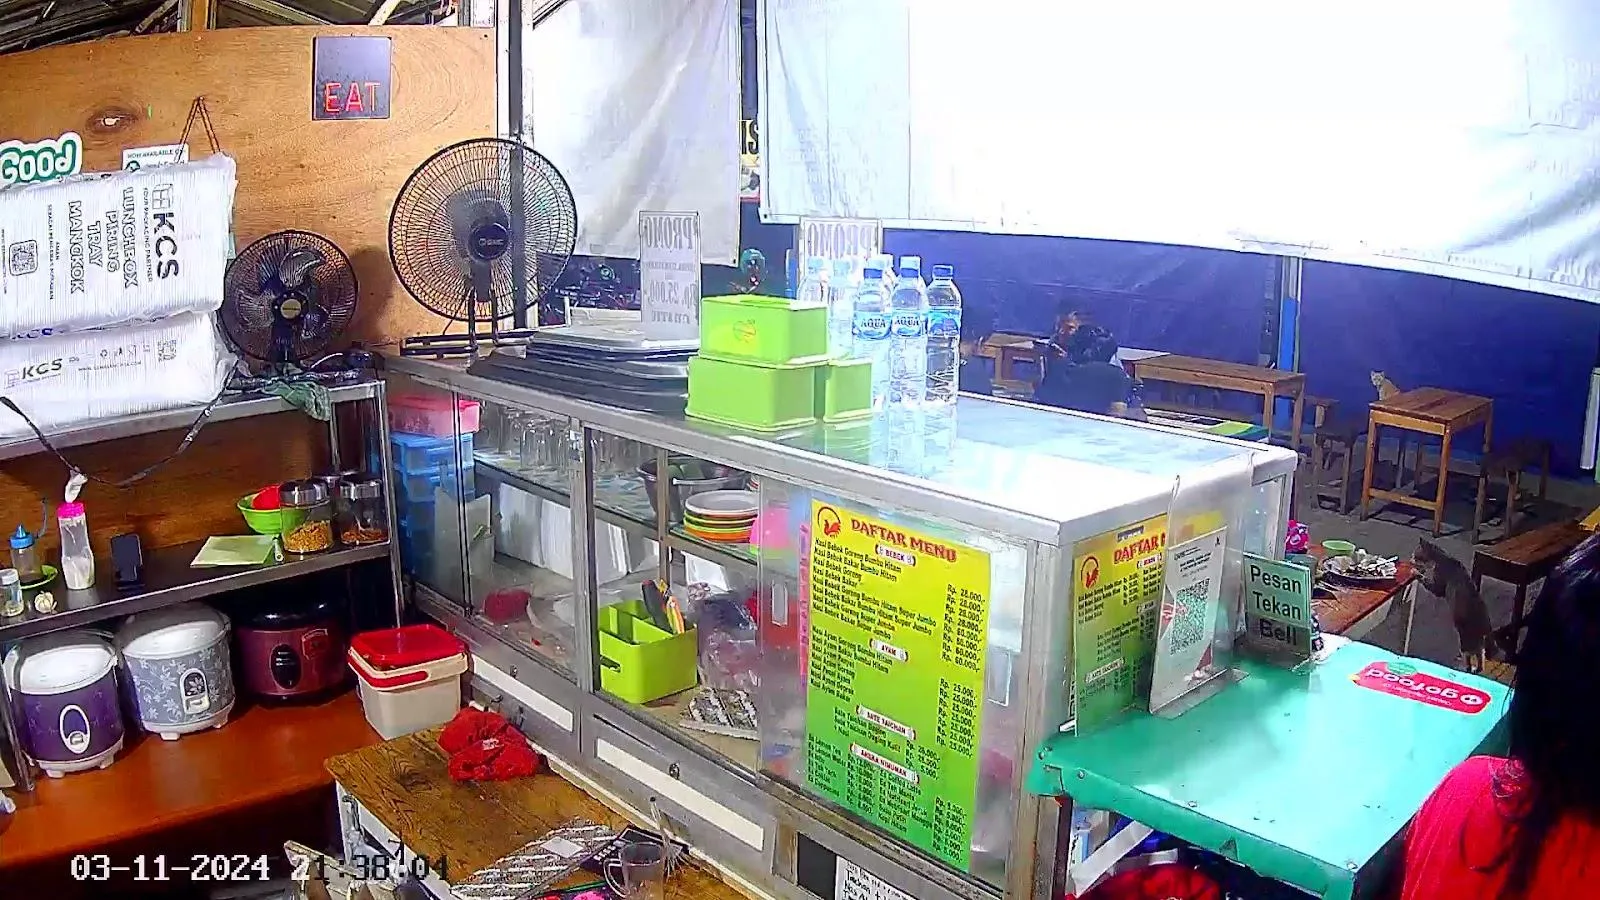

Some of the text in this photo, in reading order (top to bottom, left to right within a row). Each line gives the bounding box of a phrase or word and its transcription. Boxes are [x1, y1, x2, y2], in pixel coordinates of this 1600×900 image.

[325, 82, 380, 114] EAT
[69, 200, 85, 295] MANGKOK
[88, 221, 104, 268] TRAY
[105, 211, 121, 273] PIRING
[122, 187, 139, 289] LUNCHBOX
[153, 212, 180, 280] KCS
[860, 318, 887, 330] AQUA
[894, 315, 920, 327] AQUA
[22, 358, 63, 380] KCS
[814, 546, 825, 557] Nasi
[827, 550, 842, 563] Bebek
[815, 536, 826, 547] Nasi
[827, 541, 842, 553] Bebek
[844, 547, 863, 562] Goreng
[850, 517, 958, 563] DAFTAR MENU
[1113, 535, 1159, 565] DAFTAR
[813, 556, 862, 582] Nasi Bebek Goreng
[885, 548, 904, 562] BEBEK
[813, 565, 857, 588] Nasi Bebek Bakar
[1250, 564, 1301, 594] Pesan
[1253, 592, 1301, 621] Tekan
[1260, 620, 1297, 646] Bell
[881, 643, 896, 656] AYAM
[1366, 668, 1459, 700] gofood
